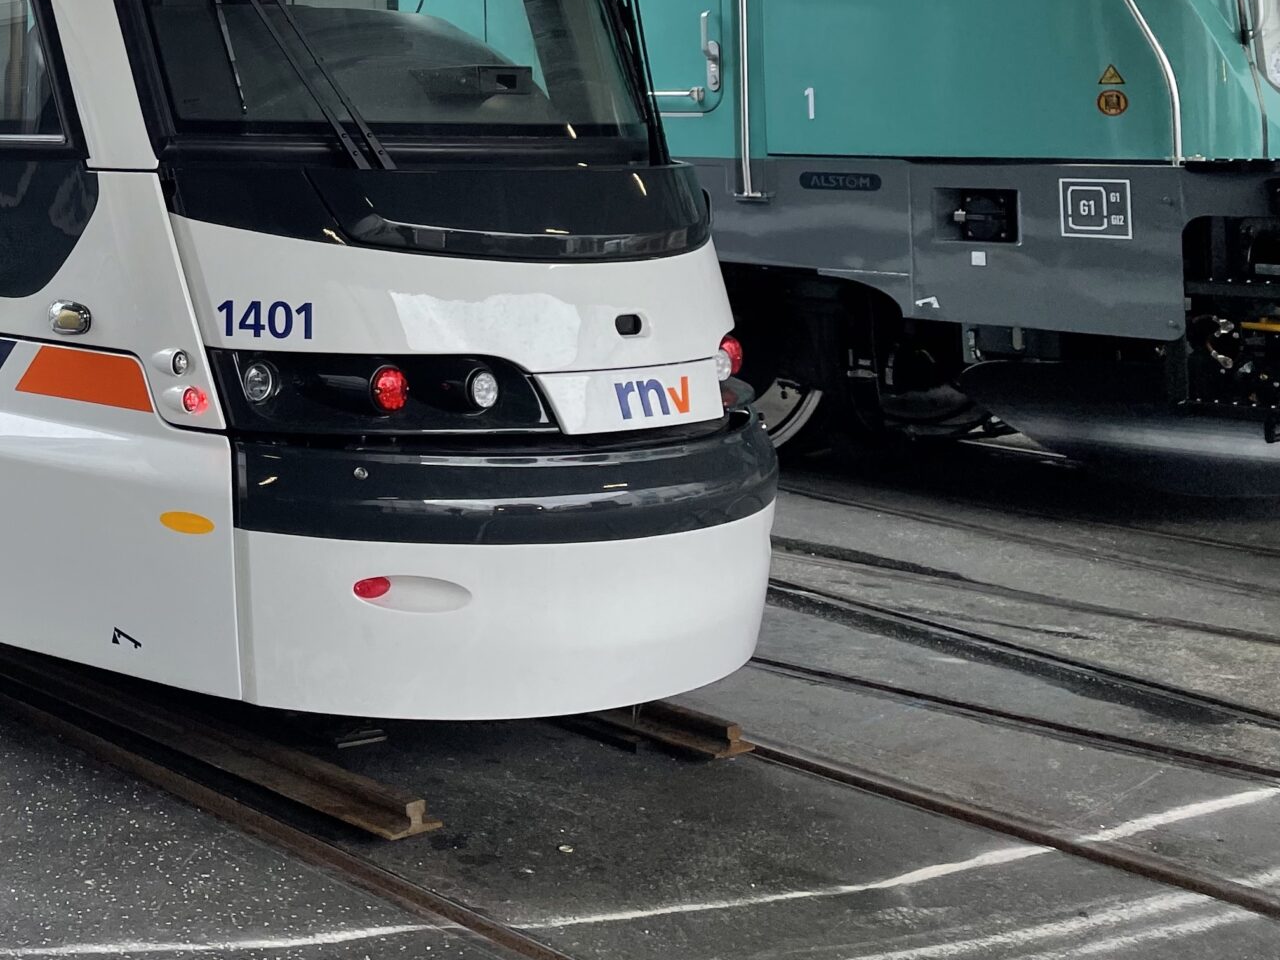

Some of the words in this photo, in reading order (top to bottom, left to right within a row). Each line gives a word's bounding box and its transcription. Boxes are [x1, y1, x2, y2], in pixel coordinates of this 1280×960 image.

[804, 87, 815, 120] 1
[810, 175, 871, 188] ALSTOM
[1080, 200, 1095, 216] G1
[1110, 192, 1120, 202] G1
[217, 300, 312, 340] 1401
[614, 376, 689, 420] rnv
